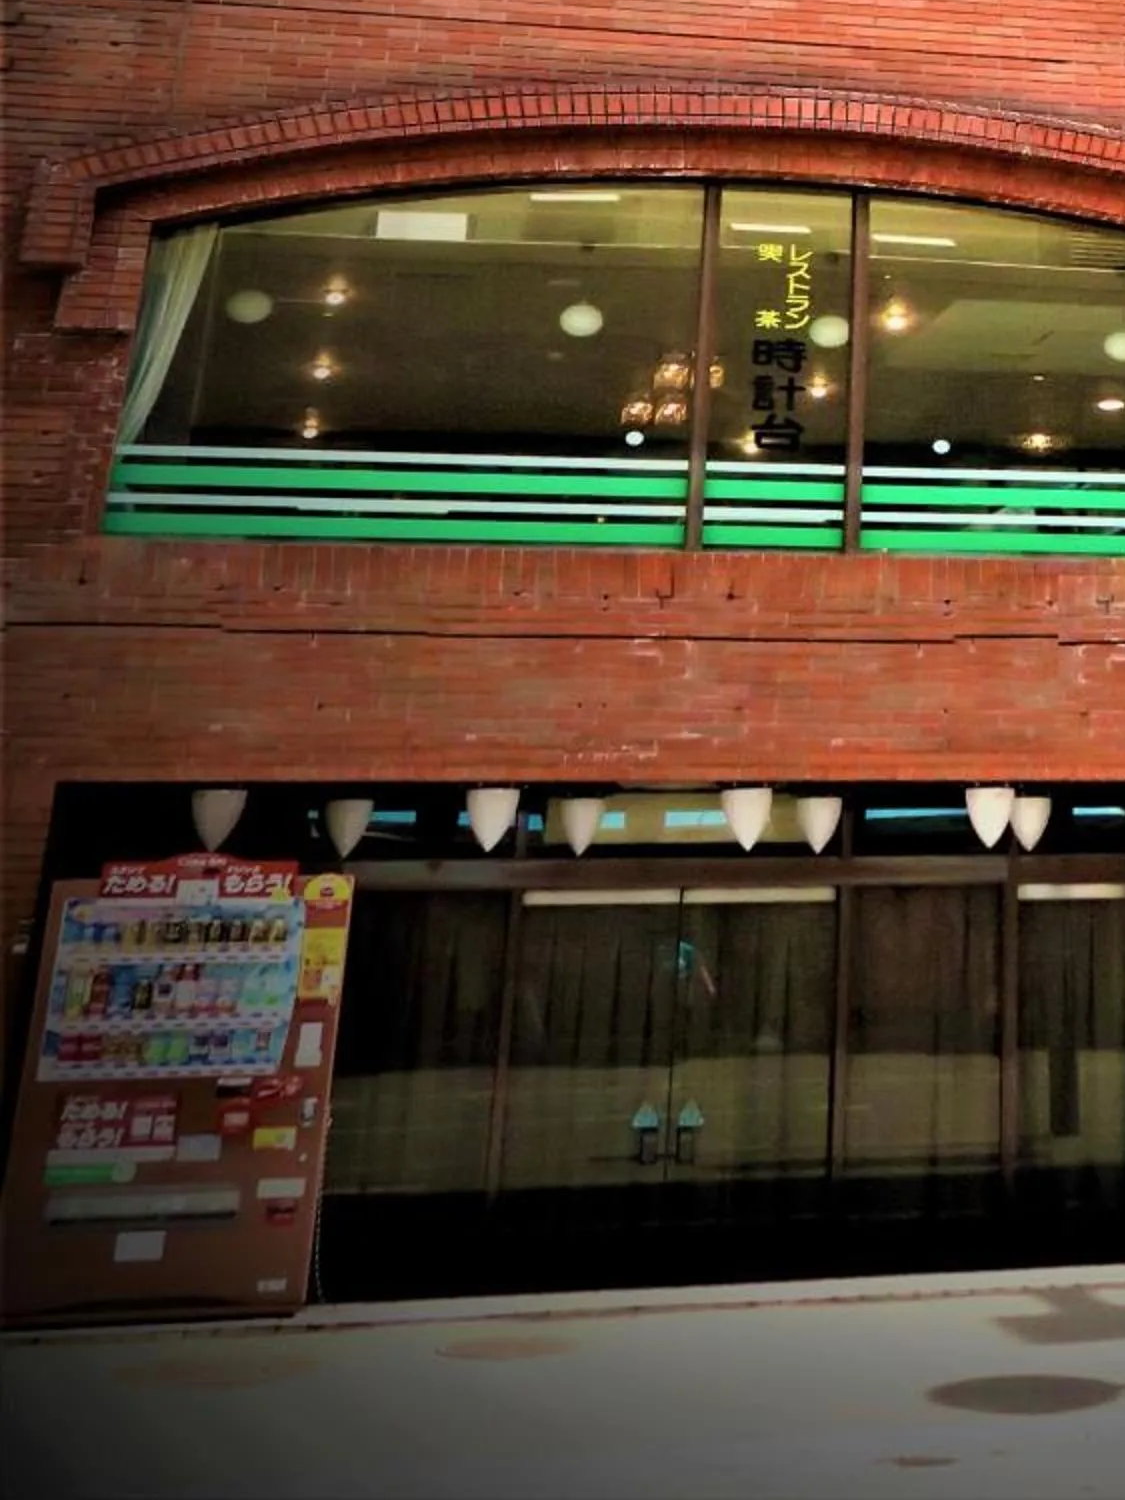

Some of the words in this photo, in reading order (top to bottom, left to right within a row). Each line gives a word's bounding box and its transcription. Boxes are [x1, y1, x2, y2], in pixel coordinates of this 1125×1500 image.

[784, 243, 813, 330] レストラン
[751, 338, 807, 450] 時計台
